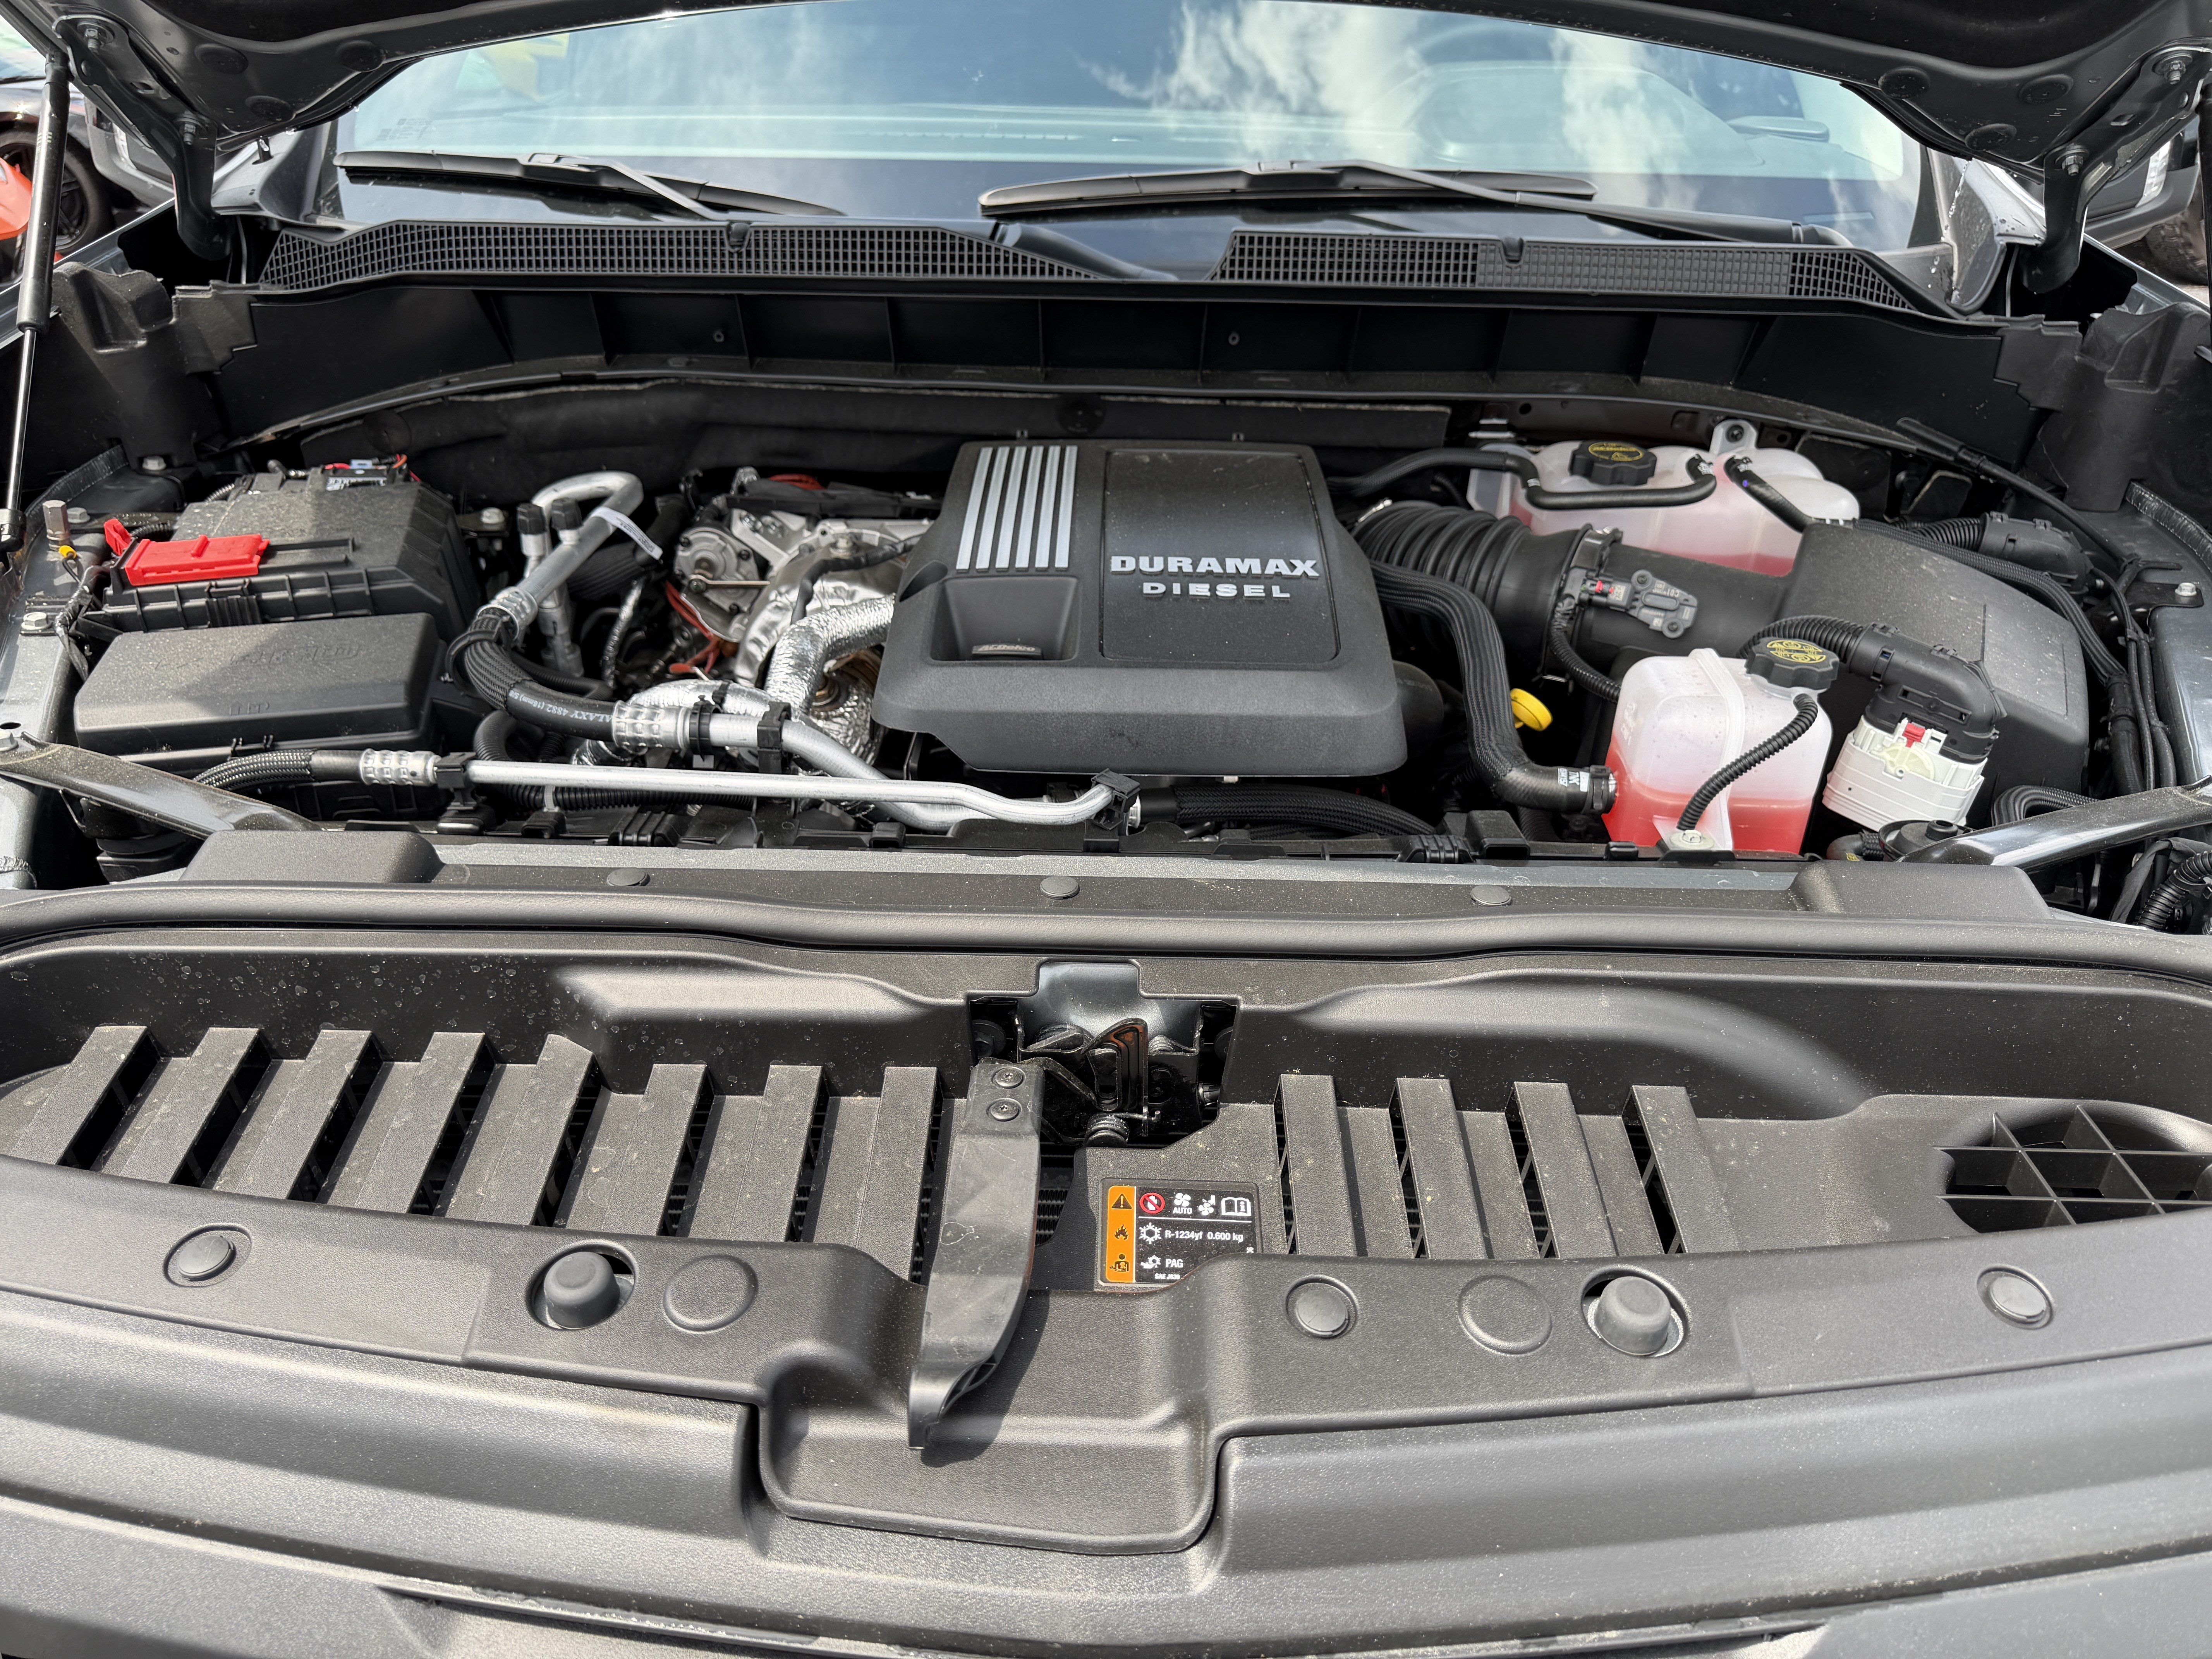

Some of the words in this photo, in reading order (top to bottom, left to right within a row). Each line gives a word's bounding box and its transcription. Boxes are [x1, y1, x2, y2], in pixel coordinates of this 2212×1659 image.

[1110, 556, 1319, 578] DURAMAX
[1142, 582, 1291, 598] DIESEL
[570, 710, 613, 723] ALAXY
[1164, 1230, 1203, 1241] R-1234yf
[1207, 1231, 1231, 1240] 0.600
[1232, 1232, 1243, 1242] kg
[1165, 1258, 1184, 1268] PAG
